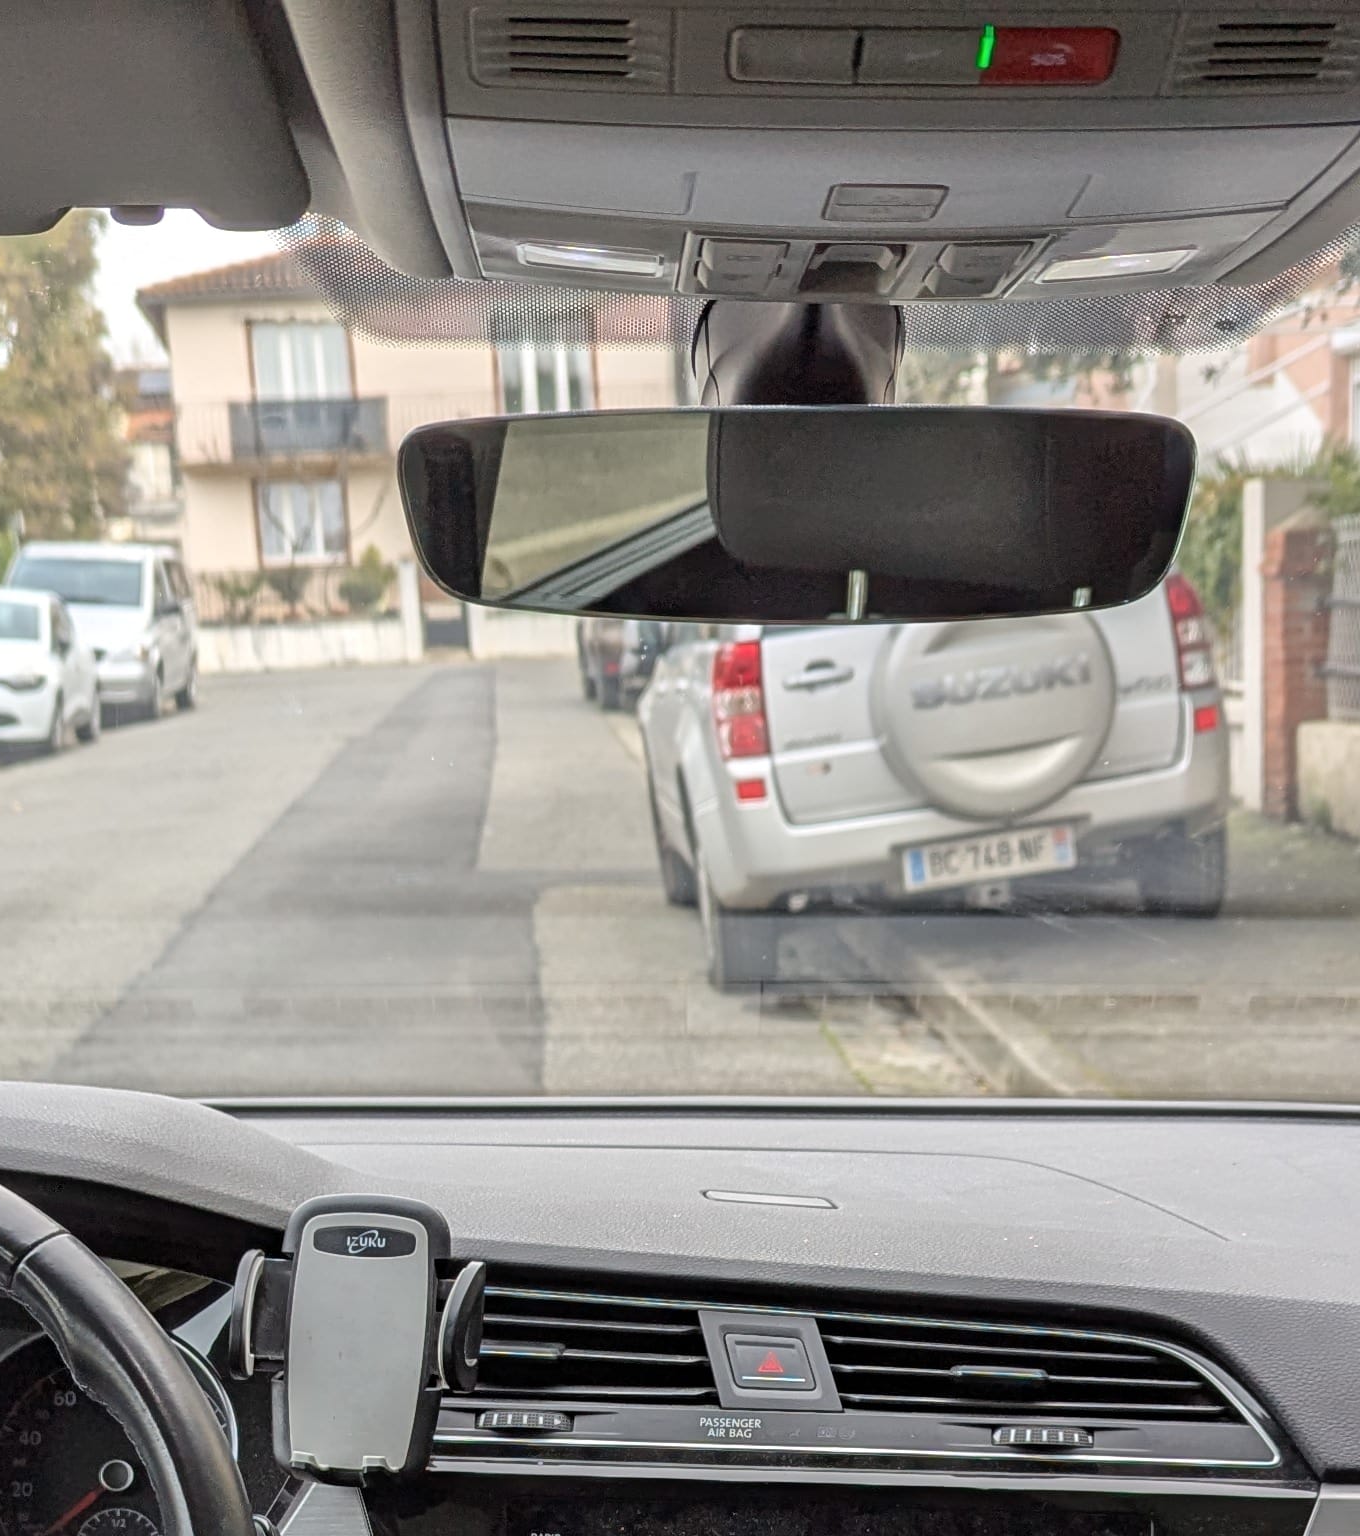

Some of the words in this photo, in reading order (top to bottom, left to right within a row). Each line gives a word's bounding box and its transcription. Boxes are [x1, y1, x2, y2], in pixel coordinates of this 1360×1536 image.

[912, 653, 1091, 709] SUZUKI
[346, 1230, 386, 1253] IZUKU
[53, 1391, 77, 1406] 60
[699, 1417, 762, 1429] PASSENGER
[19, 1430, 41, 1445] 40
[707, 1428, 726, 1437] AIR
[729, 1428, 752, 1438] BAG
[12, 1481, 33, 1497] 20
[111, 1518, 126, 1528] 1/2
